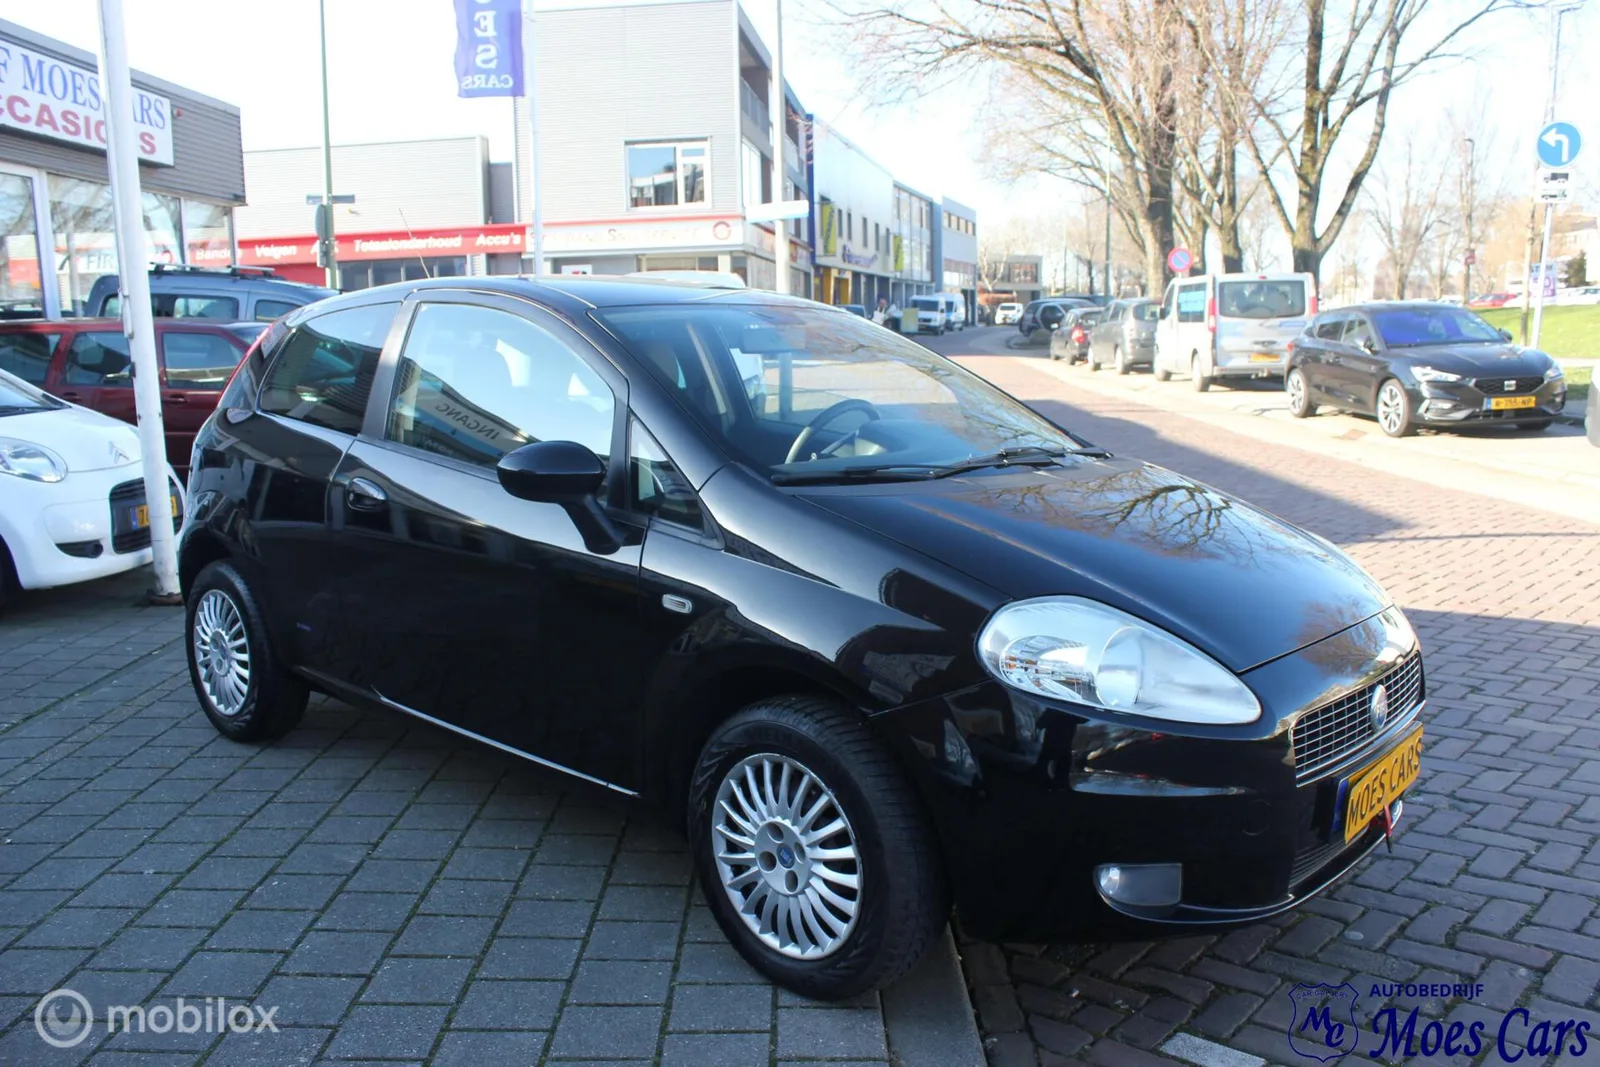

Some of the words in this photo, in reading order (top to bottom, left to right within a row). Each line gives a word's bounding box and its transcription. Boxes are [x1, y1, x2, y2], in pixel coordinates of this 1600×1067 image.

[20, 53, 101, 112] MOES
[1347, 767, 1387, 832] MOES
[1389, 736, 1422, 793] CARS
